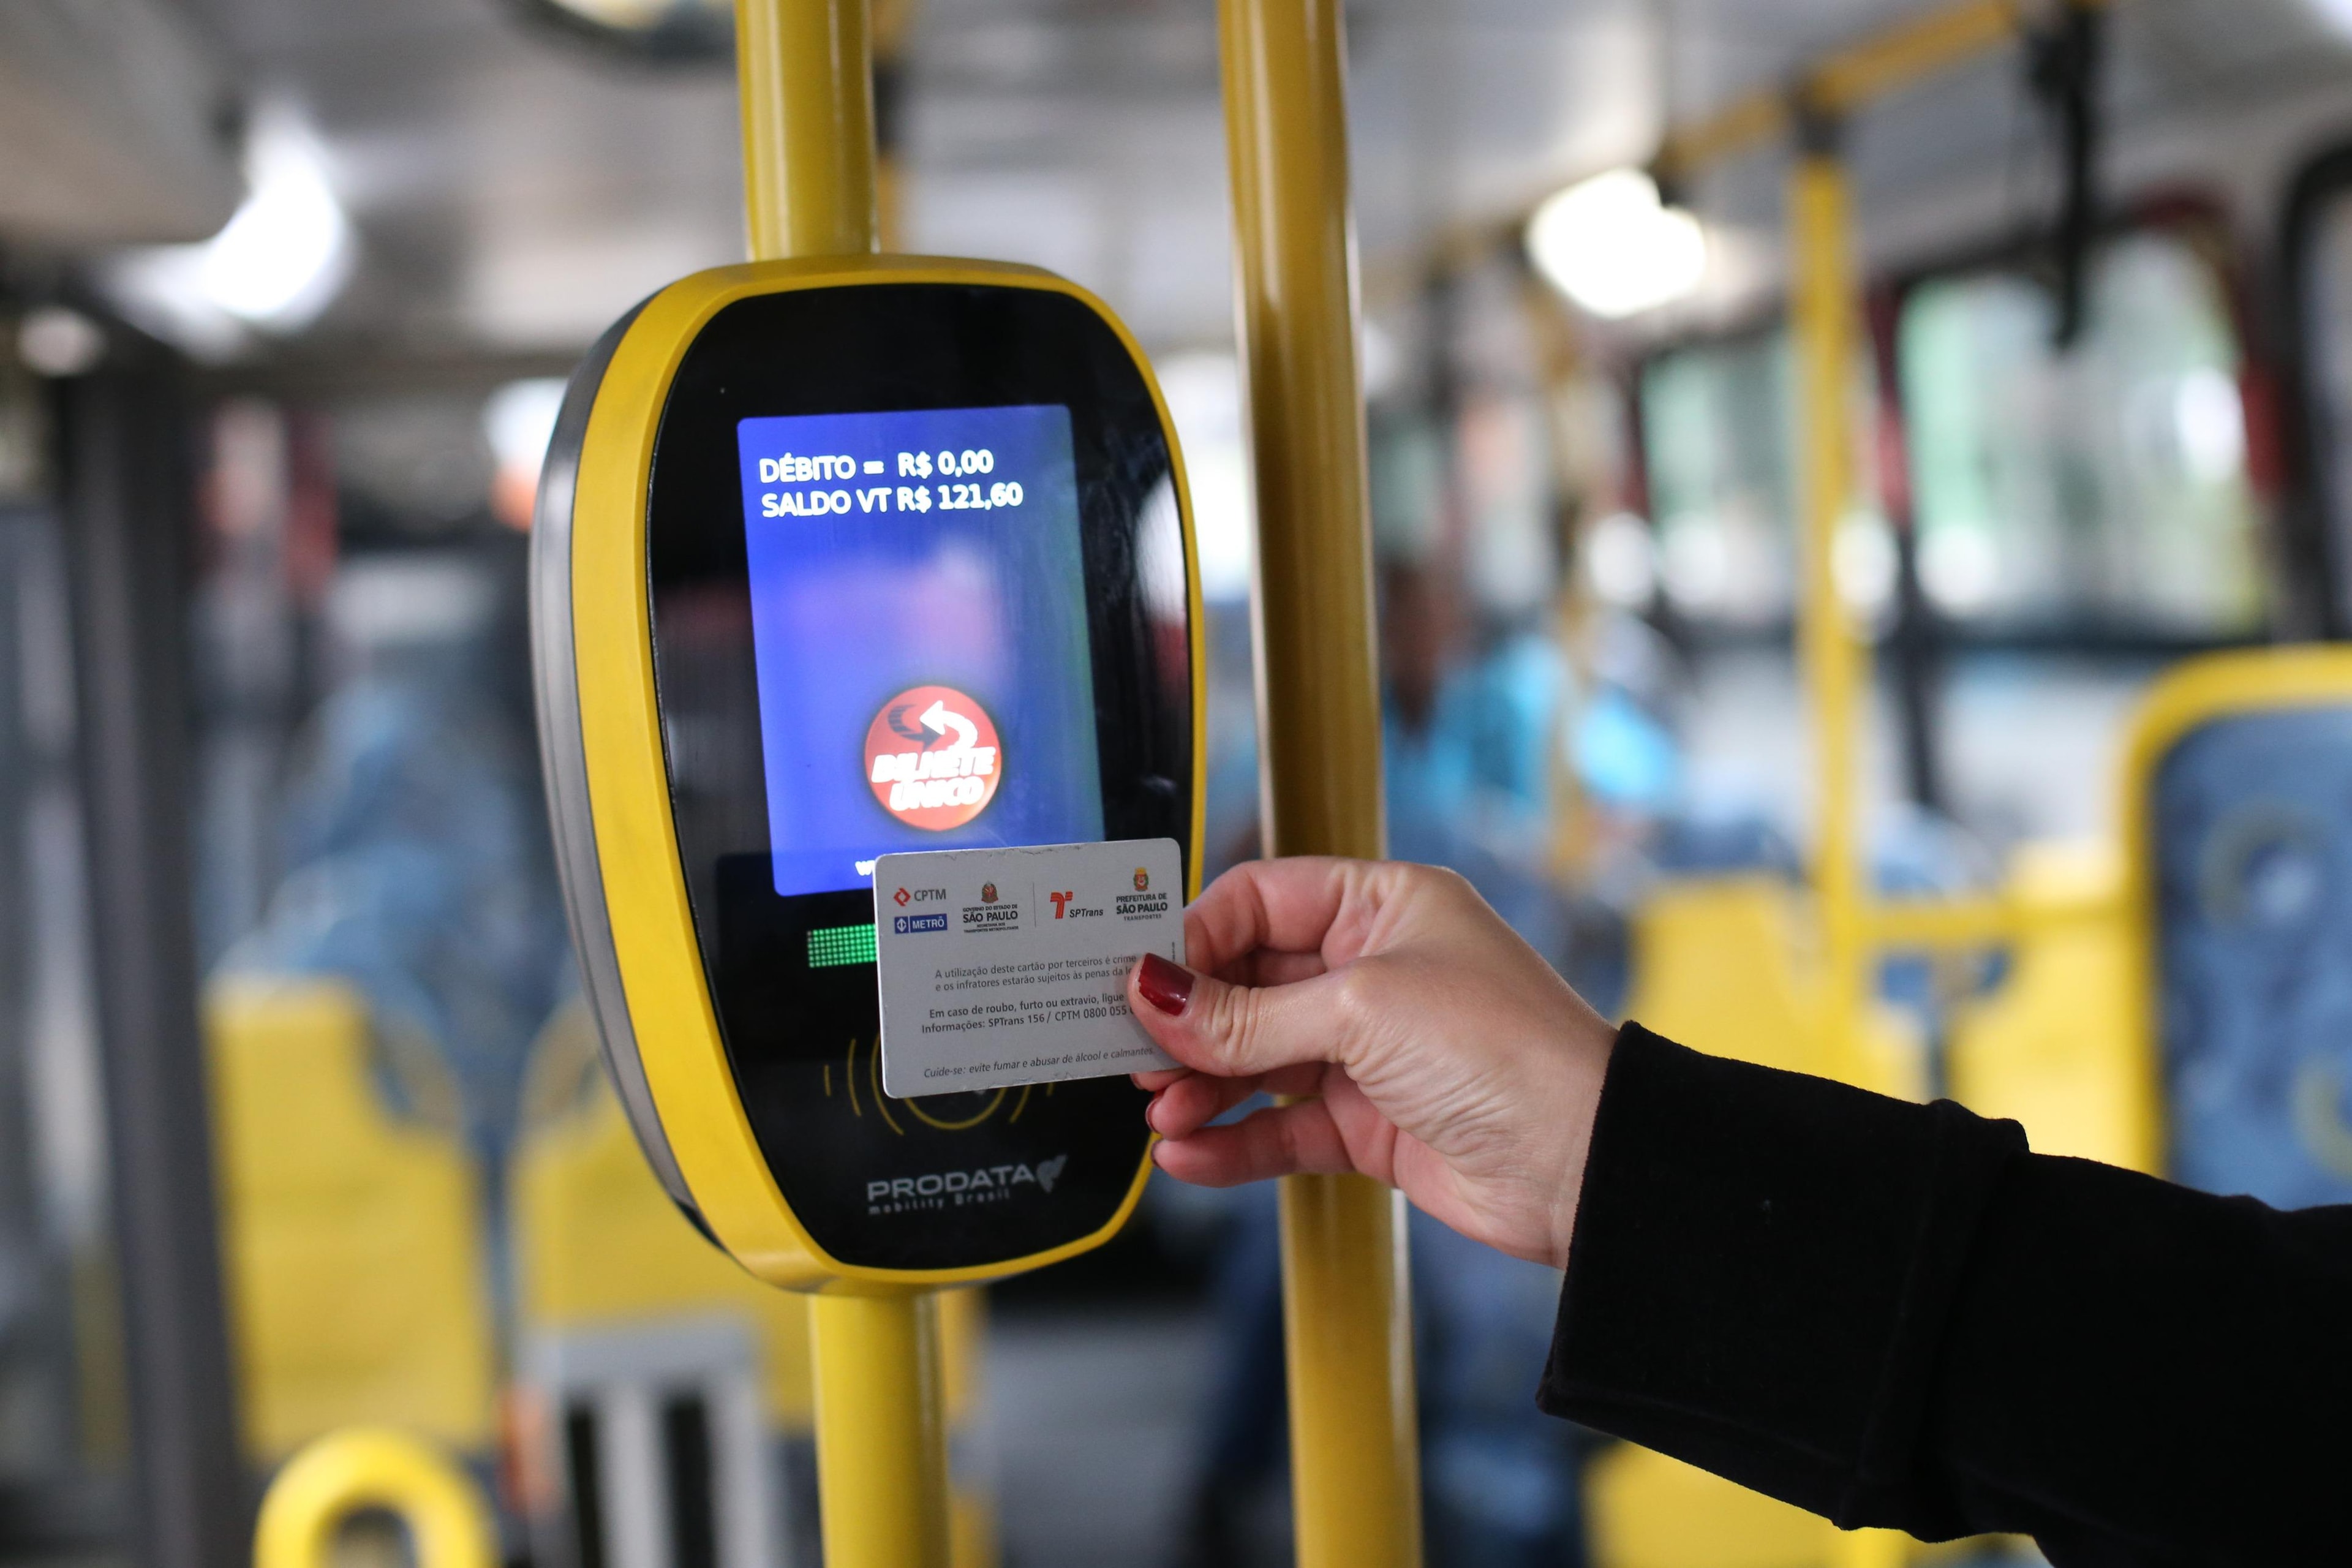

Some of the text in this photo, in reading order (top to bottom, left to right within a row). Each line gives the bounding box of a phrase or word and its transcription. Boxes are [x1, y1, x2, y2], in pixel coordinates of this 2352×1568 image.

[759, 453, 856, 483] DÉBITO
[897, 451, 933, 478] R$
[937, 449, 994, 477] 0,00
[761, 482, 1023, 518] SALDO VT R$ 121,60
[914, 889, 946, 902] CPTM
[1116, 894, 1156, 903] PREFEITURA
[963, 910, 1018, 923] SÃO PAULO
[1069, 908, 1103, 918] SPTrans
[1116, 902, 1167, 914] SÃO PAULO
[913, 916, 944, 929] METRÔ
[935, 955, 1136, 979] A utilização deste cartão por terceiros é crime
[957, 979, 1000, 990] infratores
[1003, 975, 1035, 986] estarão
[1038, 971, 1070, 984] sujeitos
[1073, 970, 1082, 979] às
[1085, 970, 1110, 979] penas
[1112, 967, 1123, 976] da
[930, 993, 1124, 1019] Em caso de roubo, furto ou extravio, ligue
[922, 1020, 985, 1034] Informações:
[988, 1017, 1024, 1028] SPTrans
[1028, 1014, 1045, 1023] 156
[1055, 1010, 1080, 1021] CPTM
[1084, 1007, 1106, 1019] 0800
[1110, 1005, 1127, 1016] 055
[924, 1066, 966, 1078] Cuide-se:
[969, 1063, 990, 1074] evite
[993, 1060, 1020, 1071] fumar
[1030, 1056, 1060, 1067] abusar
[1062, 1055, 1072, 1064] de
[1075, 1051, 1101, 1062] álcool
[867, 1164, 1035, 1202] PRODATA
[869, 1197, 944, 1215] mobility
